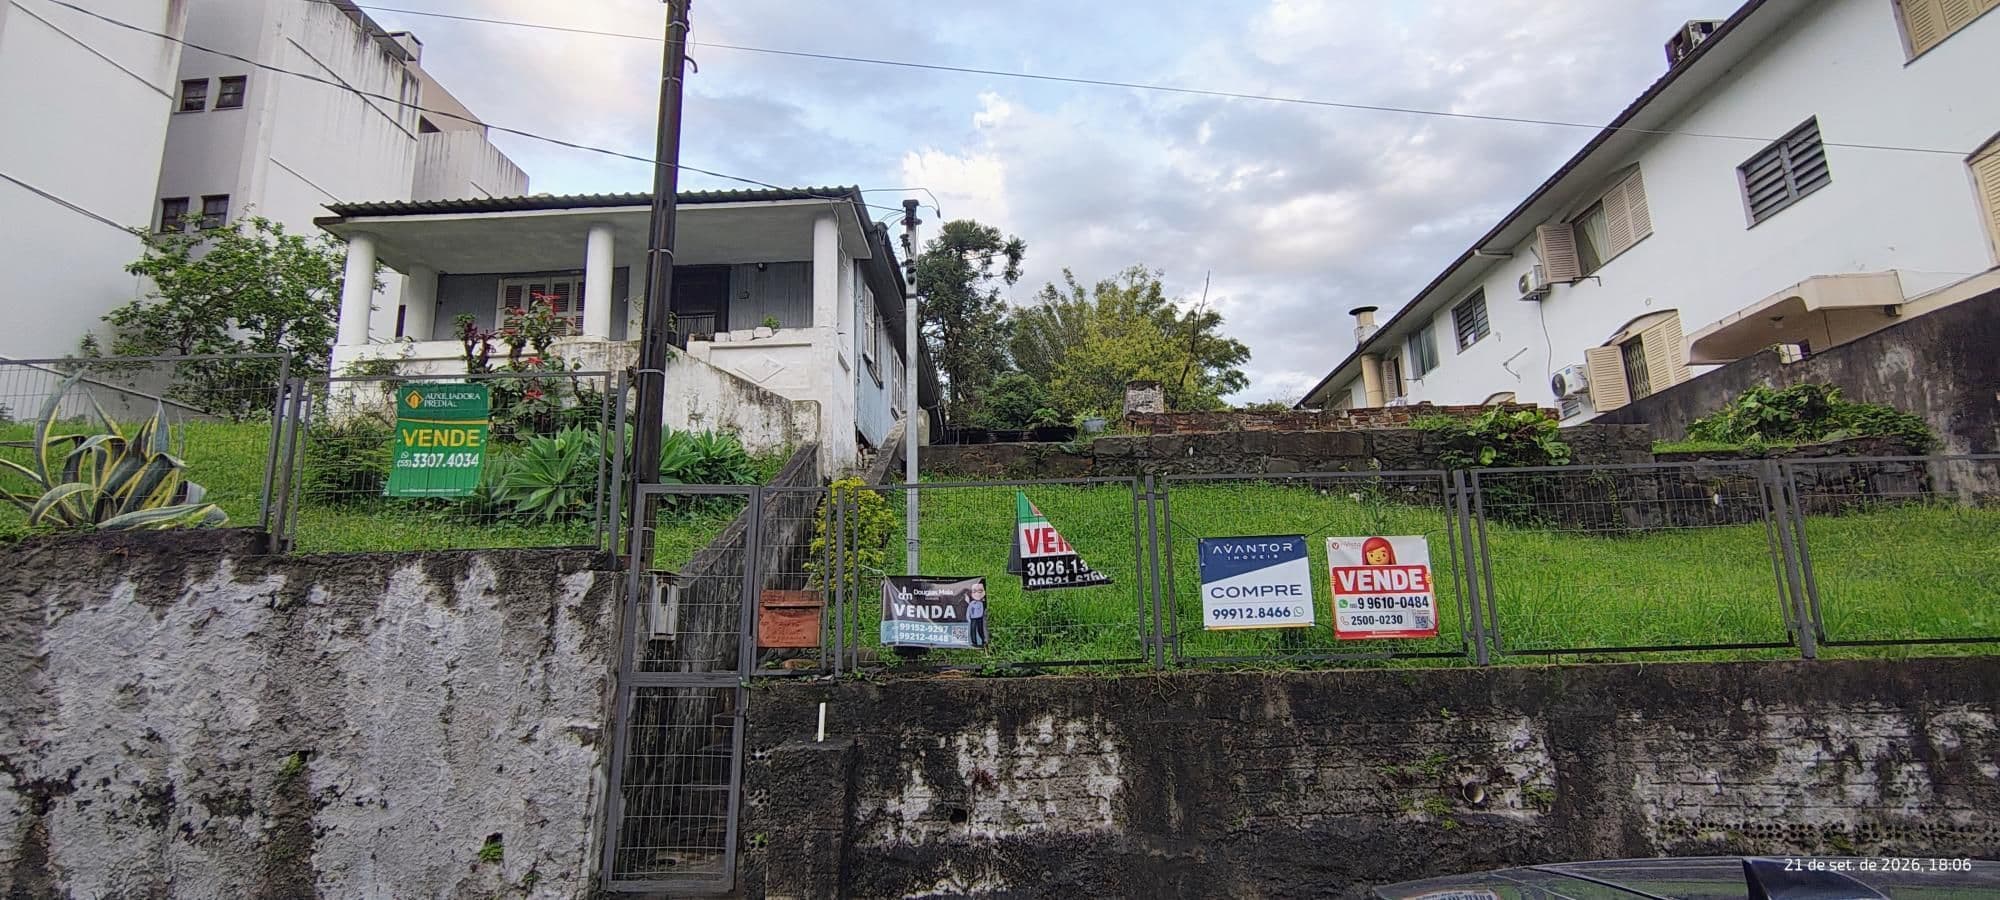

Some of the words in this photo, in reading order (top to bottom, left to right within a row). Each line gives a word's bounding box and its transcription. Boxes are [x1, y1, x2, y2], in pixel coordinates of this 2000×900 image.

[424, 392, 481, 401] AUXILIADORA
[424, 399, 458, 408] PREDIAL
[402, 428, 481, 447] VENDE
[412, 452, 480, 468] 3307.4034
[1212, 543, 1293, 554] AVANTOR
[1337, 568, 1425, 592] VENDE
[1210, 584, 1303, 599] COMPRE
[1367, 595, 1429, 609] 9610-0484
[894, 603, 957, 619] VENDA
[1212, 606, 1291, 620] 99912.8466
[1351, 614, 1403, 626] 2500-0230
